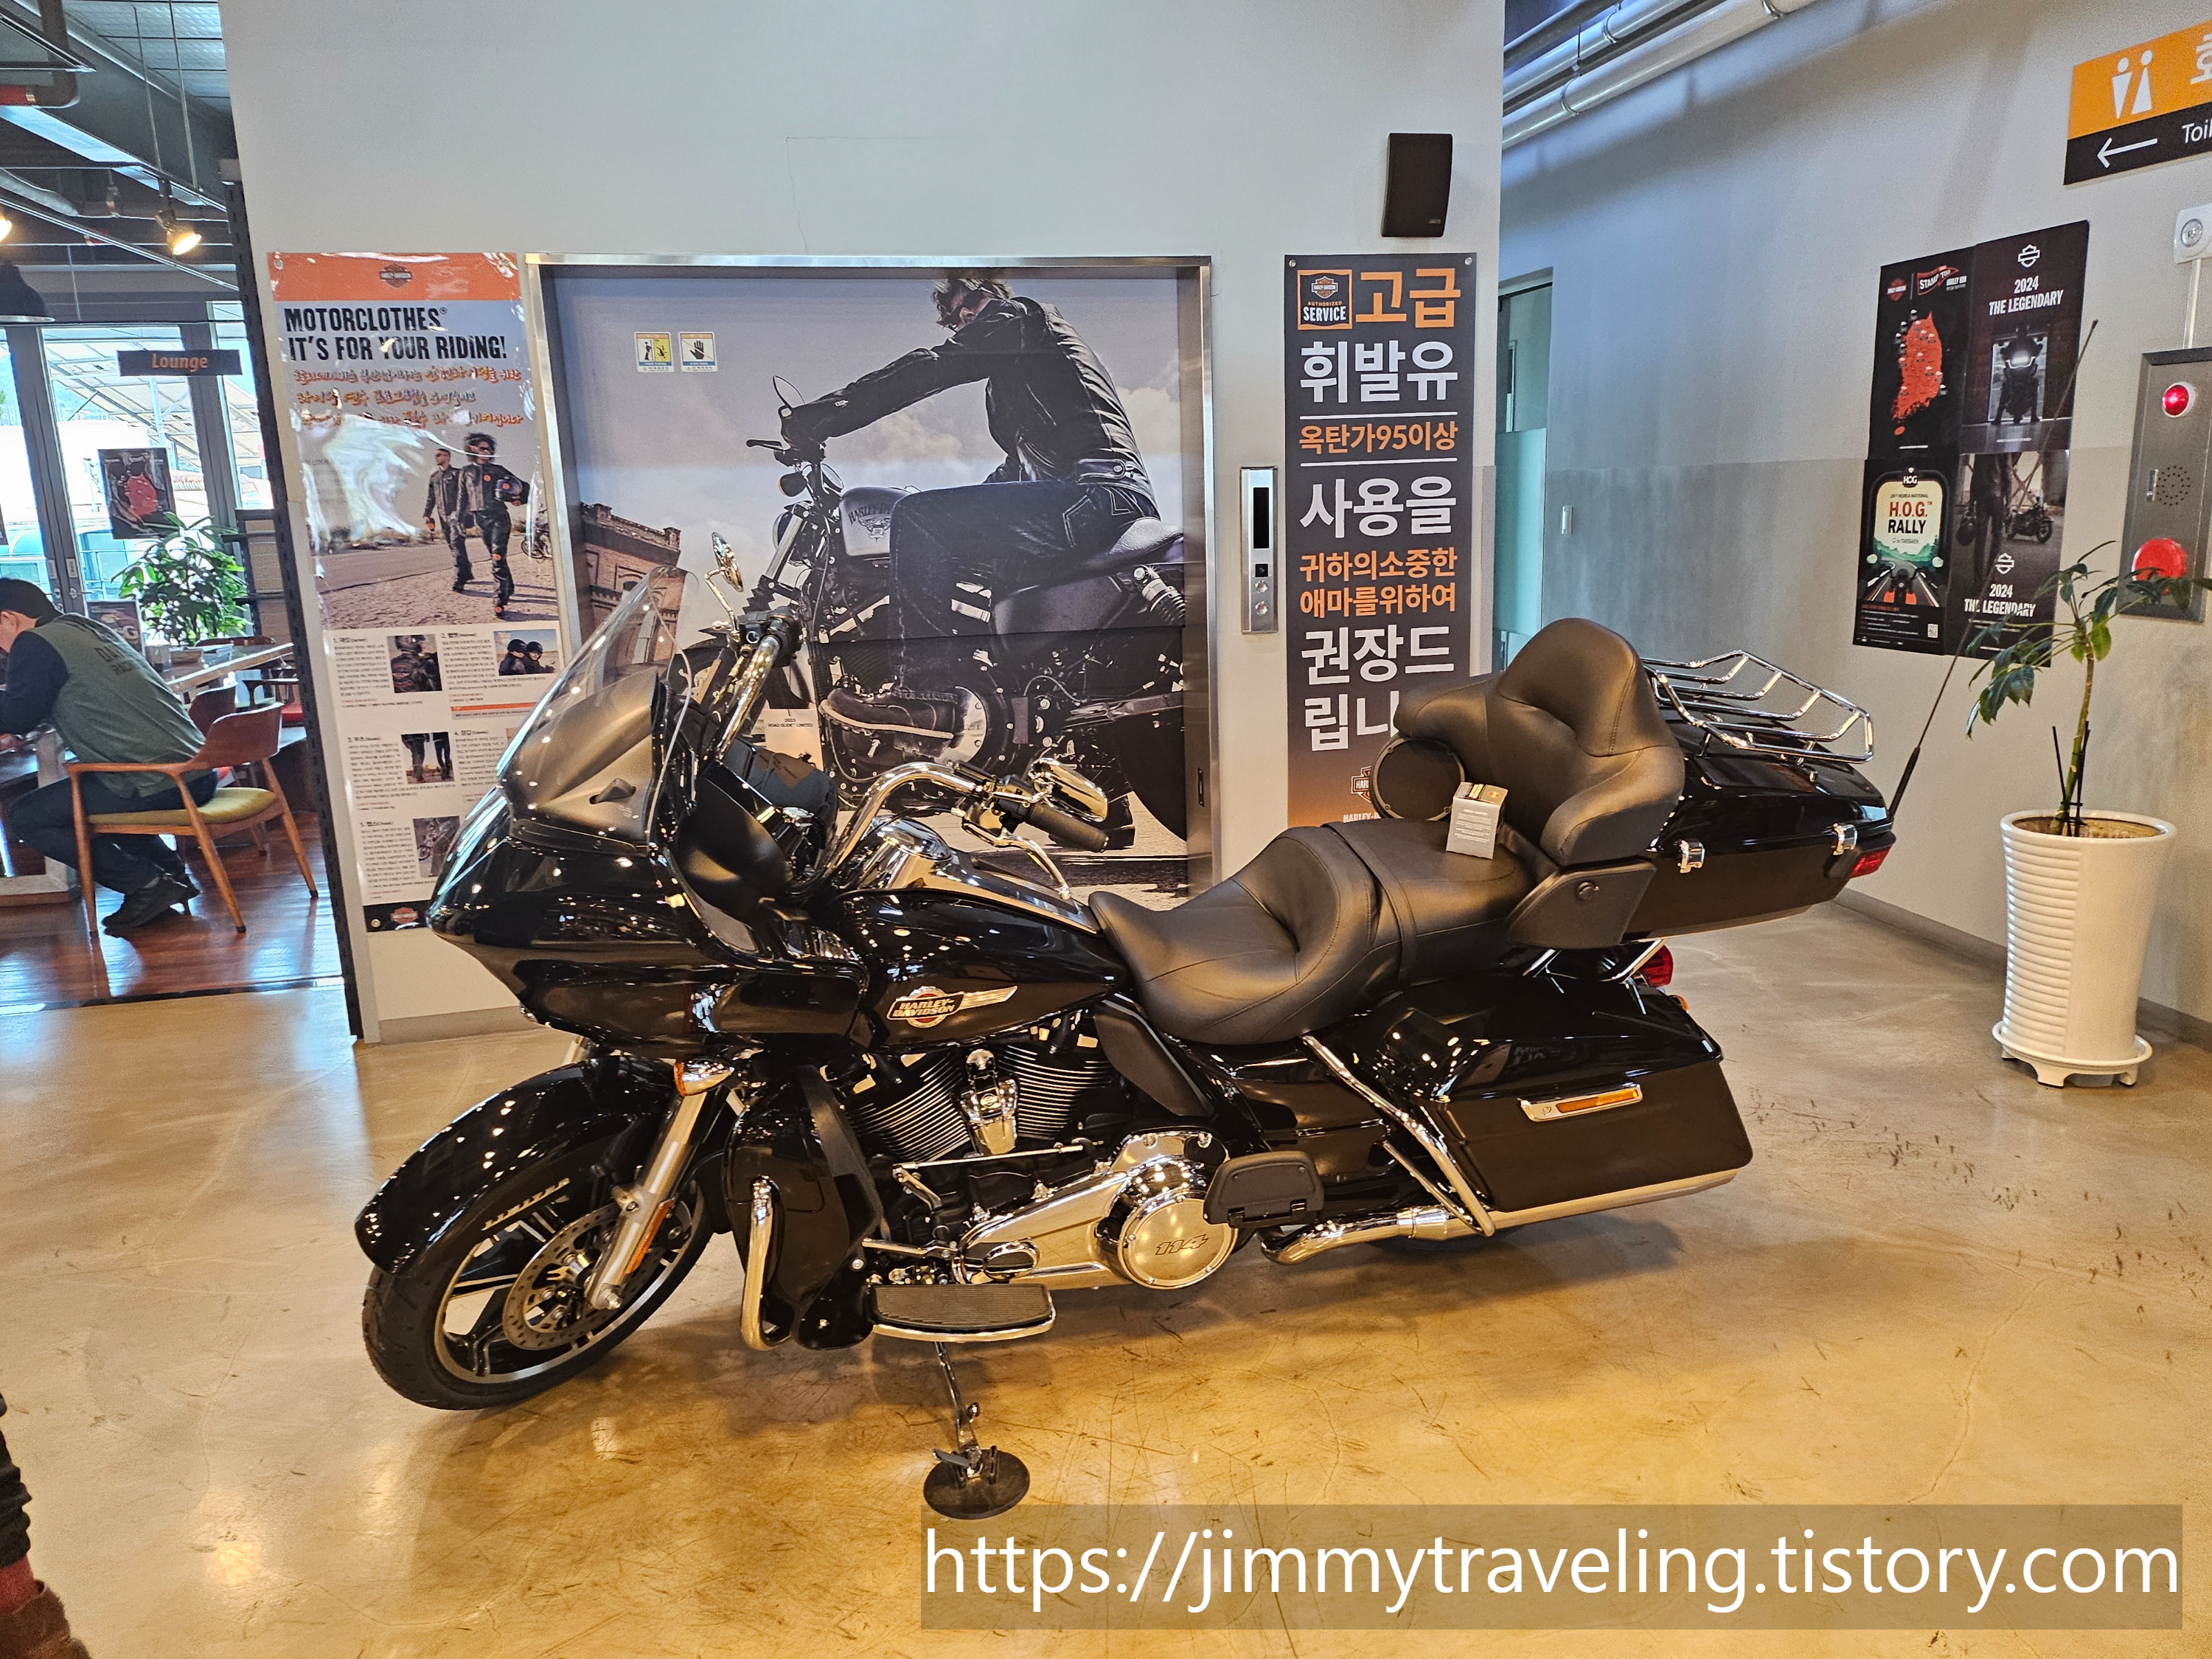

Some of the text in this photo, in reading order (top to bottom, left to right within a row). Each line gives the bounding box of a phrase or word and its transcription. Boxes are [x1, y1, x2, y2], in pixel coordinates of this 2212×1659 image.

[1919, 274, 1939, 290] STAMP
[2014, 276, 2039, 294] 2024
[1355, 268, 1461, 329] 고급
[1989, 290, 2064, 316] THE LEGENDARY
[1303, 306, 1347, 322] SERVICE
[337, 336, 374, 361] FOR
[379, 336, 430, 360] YOUR
[437, 336, 507, 360] RIDING!
[150, 353, 209, 374] Lounge
[1300, 341, 1458, 403] 휘발유
[1299, 421, 1458, 455] 옥탄가95이상
[1300, 476, 1457, 539] 사용을
[1888, 518, 1927, 534] RALLY
[1300, 547, 1458, 583] 귀하의소중한
[1300, 582, 1456, 619] 애마를위하여
[1989, 583, 2014, 599] 2024
[1982, 599, 2037, 617] LEGENDARY
[1301, 624, 1455, 686] 권장드
[1304, 690, 1399, 752] 립니
[891, 1004, 956, 1018] DAVIDSON
[899, 998, 956, 1010] HARLEY-
[1155, 1234, 1209, 1256] 114
